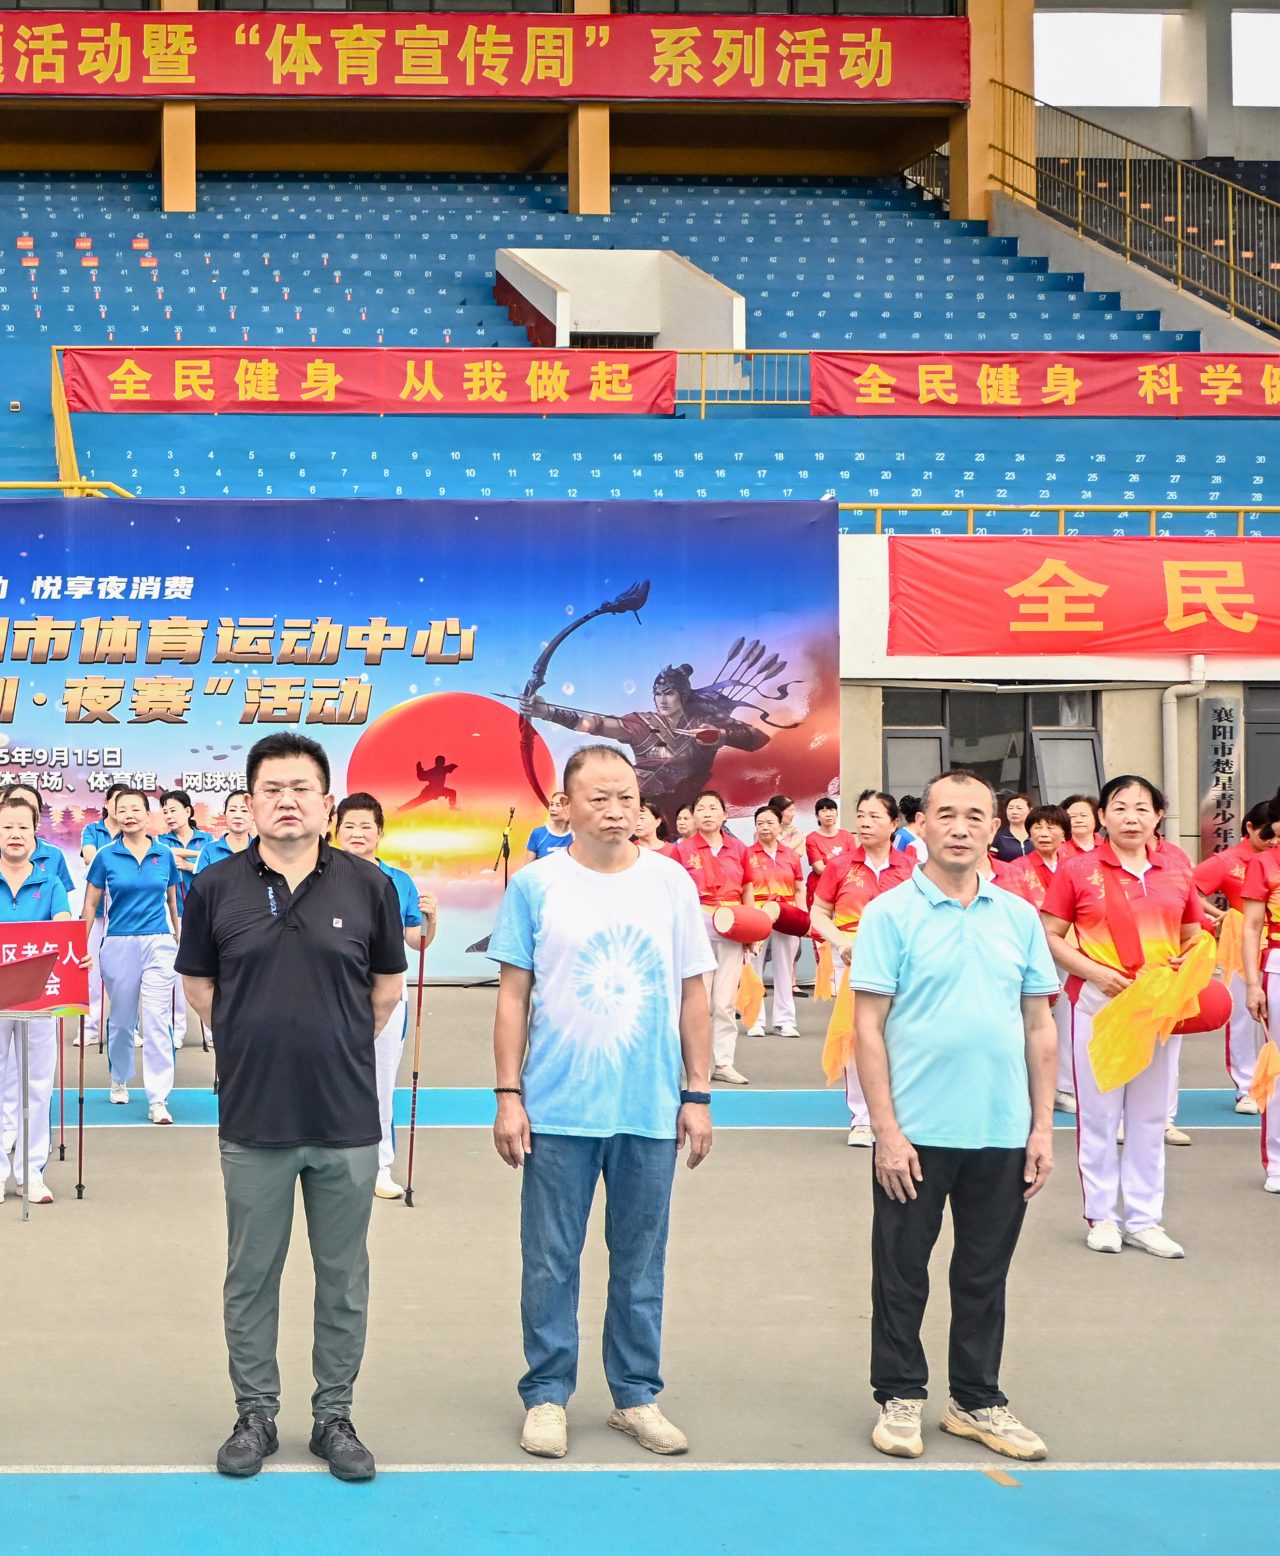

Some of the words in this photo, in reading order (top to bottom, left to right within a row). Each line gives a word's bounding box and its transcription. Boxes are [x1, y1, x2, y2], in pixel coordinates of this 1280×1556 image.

[235, 23, 610, 87] “体育宣传周”
[651, 26, 892, 88] 系列活动
[107, 358, 343, 402] 全民健身
[400, 359, 634, 402] 从我做起
[853, 363, 1083, 406] 全民健身
[86, 450, 91, 459] 1
[126, 450, 133, 460] 2
[167, 450, 174, 460] 3
[207, 450, 215, 459] 4
[248, 450, 255, 460] 5
[289, 451, 296, 460] 6
[330, 451, 337, 460] 7
[370, 451, 378, 460] 8
[411, 451, 419, 460] 9
[450, 451, 461, 460] 10
[492, 452, 501, 461] 11
[531, 451, 542, 462] 12
[572, 452, 583, 462] 13
[612, 452, 623, 462] 14
[652, 452, 664, 462] 15
[693, 452, 704, 461] 16
[733, 452, 744, 461] 17
[774, 452, 785, 461] 18
[814, 452, 825, 461] 19
[854, 452, 866, 461] 20
[895, 452, 906, 461] 21
[935, 452, 946, 461] 22
[974, 452, 986, 462] 23
[1014, 453, 1026, 463] 24
[1055, 453, 1066, 463] 25
[1095, 453, 1106, 463] 26
[1135, 454, 1147, 463] 27
[1175, 454, 1186, 463] 28
[1215, 454, 1227, 464] 29
[1255, 455, 1266, 464] 30
[31, 576, 195, 601] 悦享夜消费
[1006, 559, 1259, 633] 全民
[1211, 706, 1235, 853] 襄阳市楚星青少年
[44, 971, 62, 996] 会
